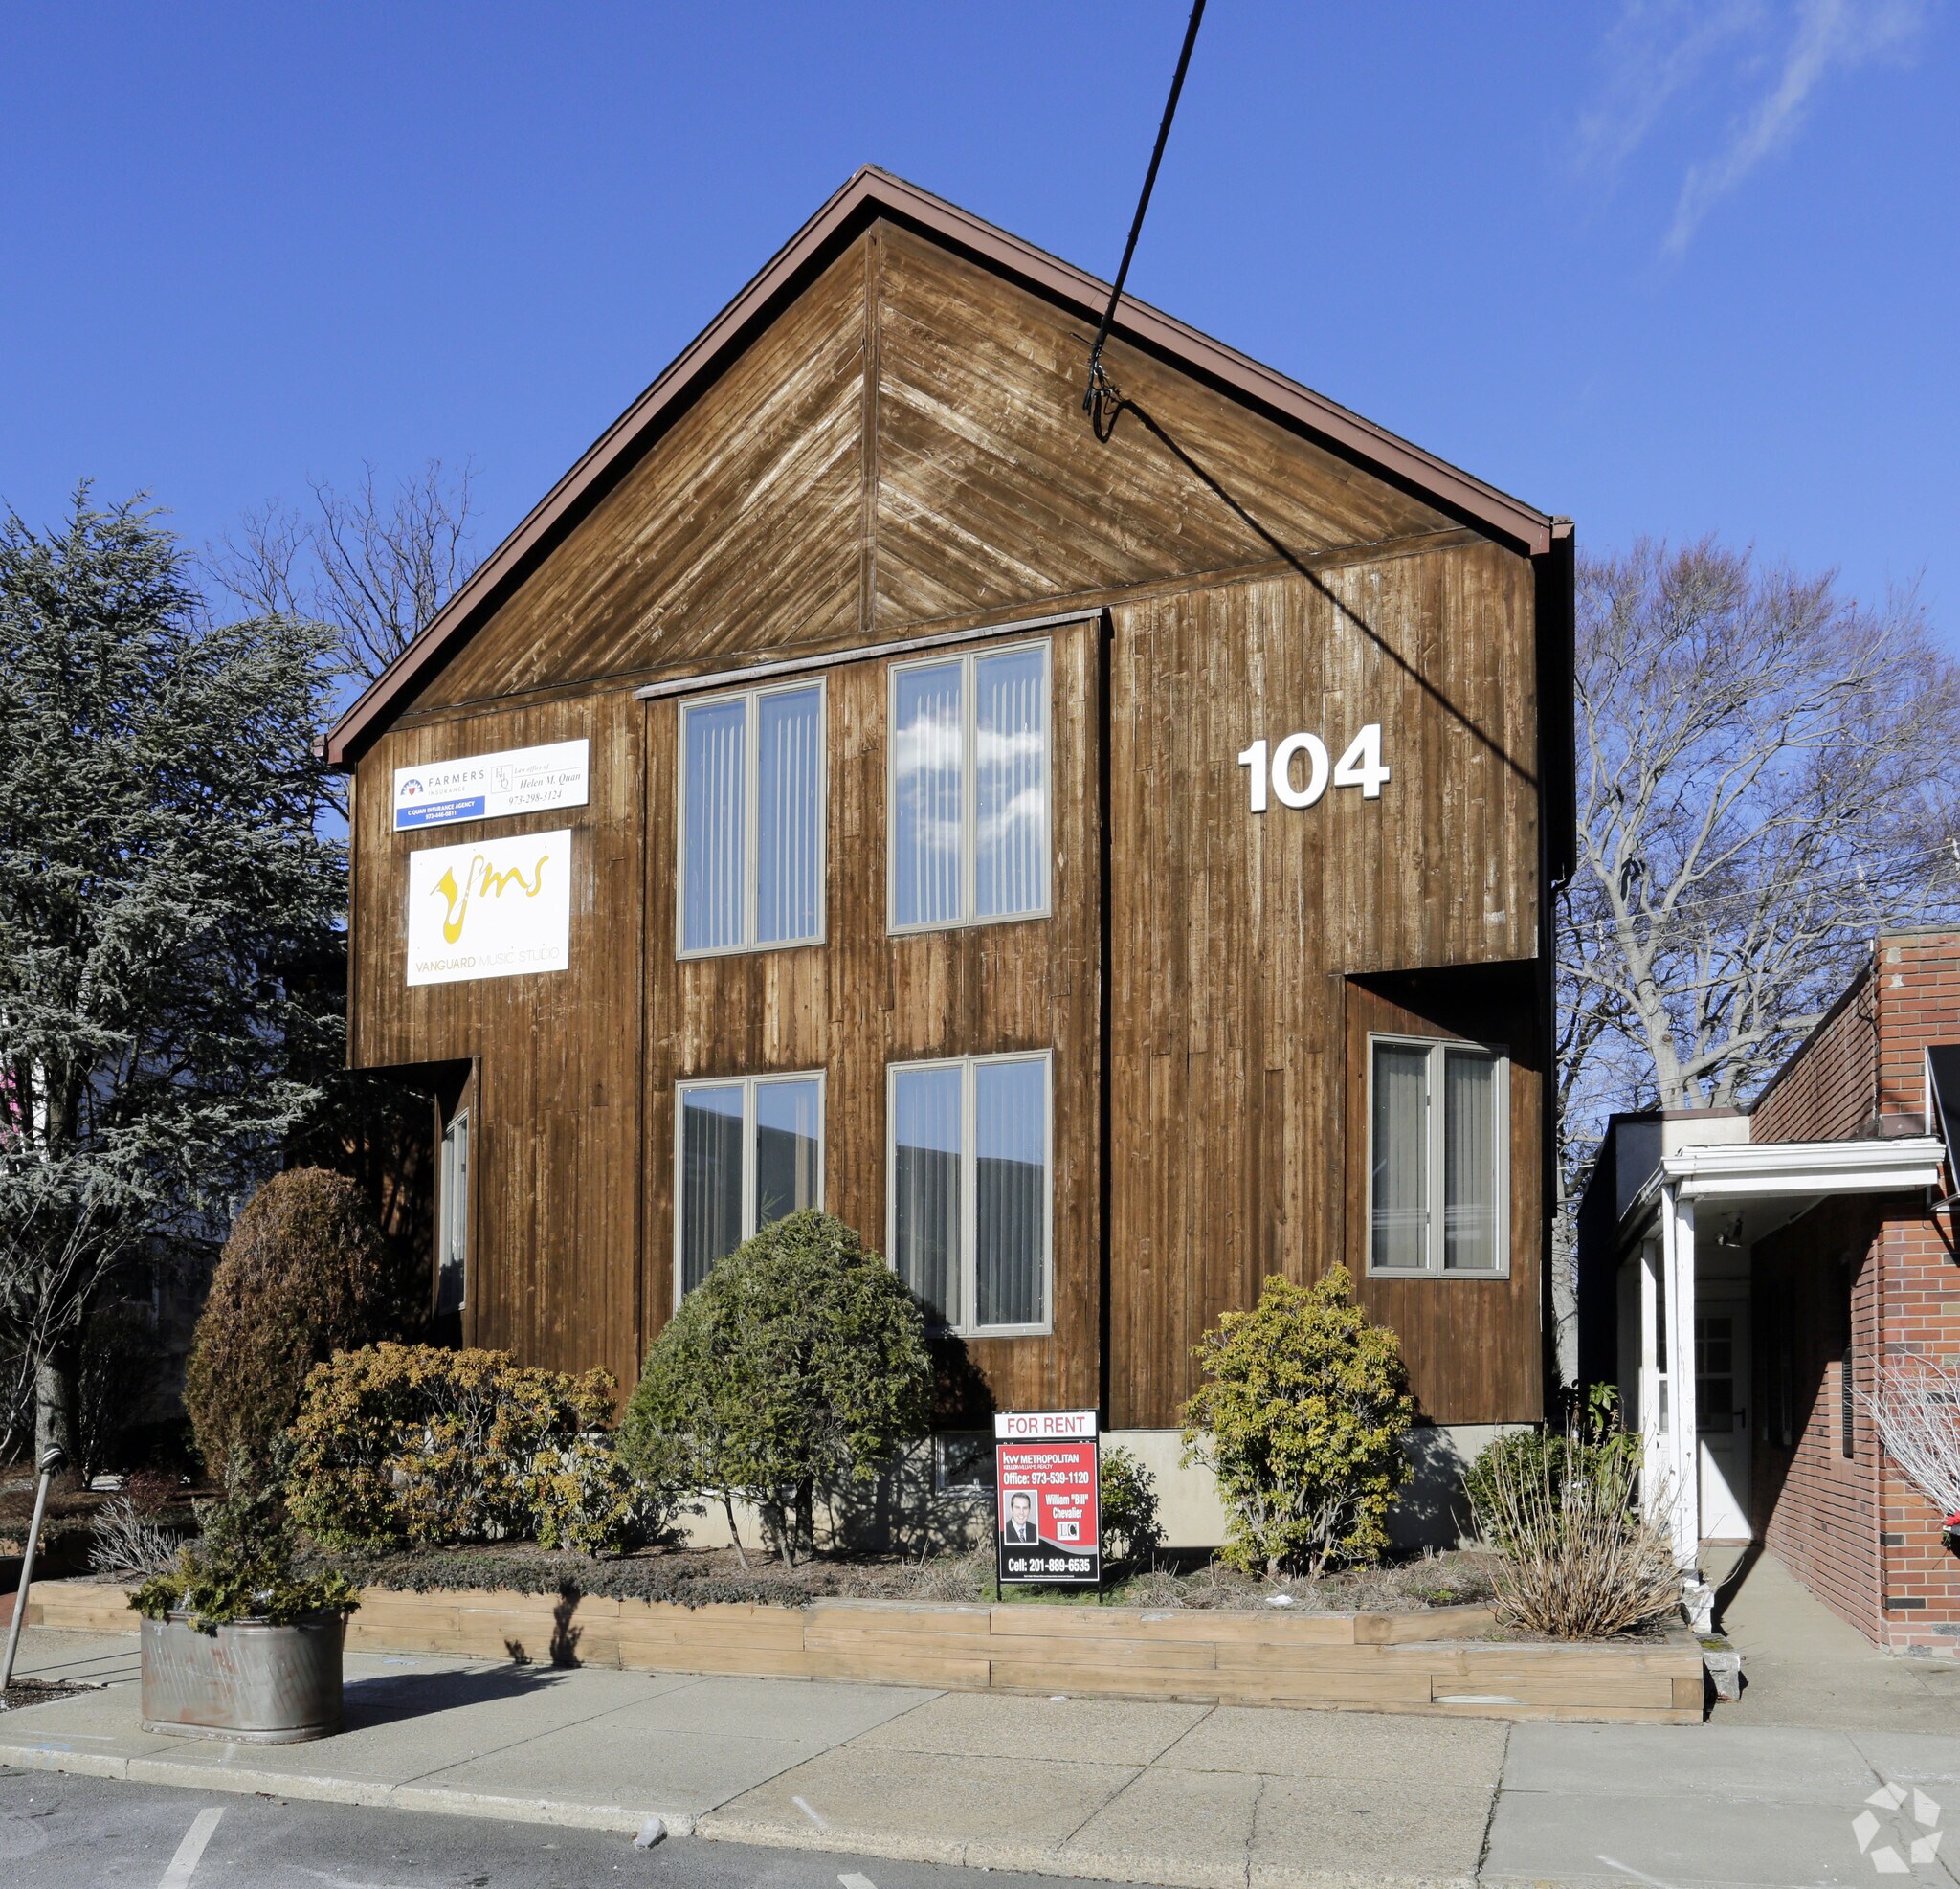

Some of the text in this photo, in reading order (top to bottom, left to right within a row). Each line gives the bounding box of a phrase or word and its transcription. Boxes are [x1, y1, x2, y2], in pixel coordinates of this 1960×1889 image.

[1237, 723, 1391, 813] 104
[428, 769, 485, 788] FARMERS
[520, 772, 581, 789] Helen M. Quan
[428, 785, 466, 796] INSURANCE
[508, 789, 563, 806] 973-298-3124
[427, 804, 455, 813] INSURANCE
[455, 800, 476, 810] AGENCY
[416, 946, 560, 973] VANGUARD MUSIC STUDIO
[1007, 1416, 1085, 1433] FOR RENT
[1002, 1451, 1080, 1464] kw METROPOLITAN
[1003, 1471, 1089, 1485] Office: 973-539-1120
[1045, 1493, 1089, 1505] William "Bill"
[1052, 1506, 1083, 1519] Chevalier
[1008, 1557, 1091, 1572] Cell: 201-889-6535
